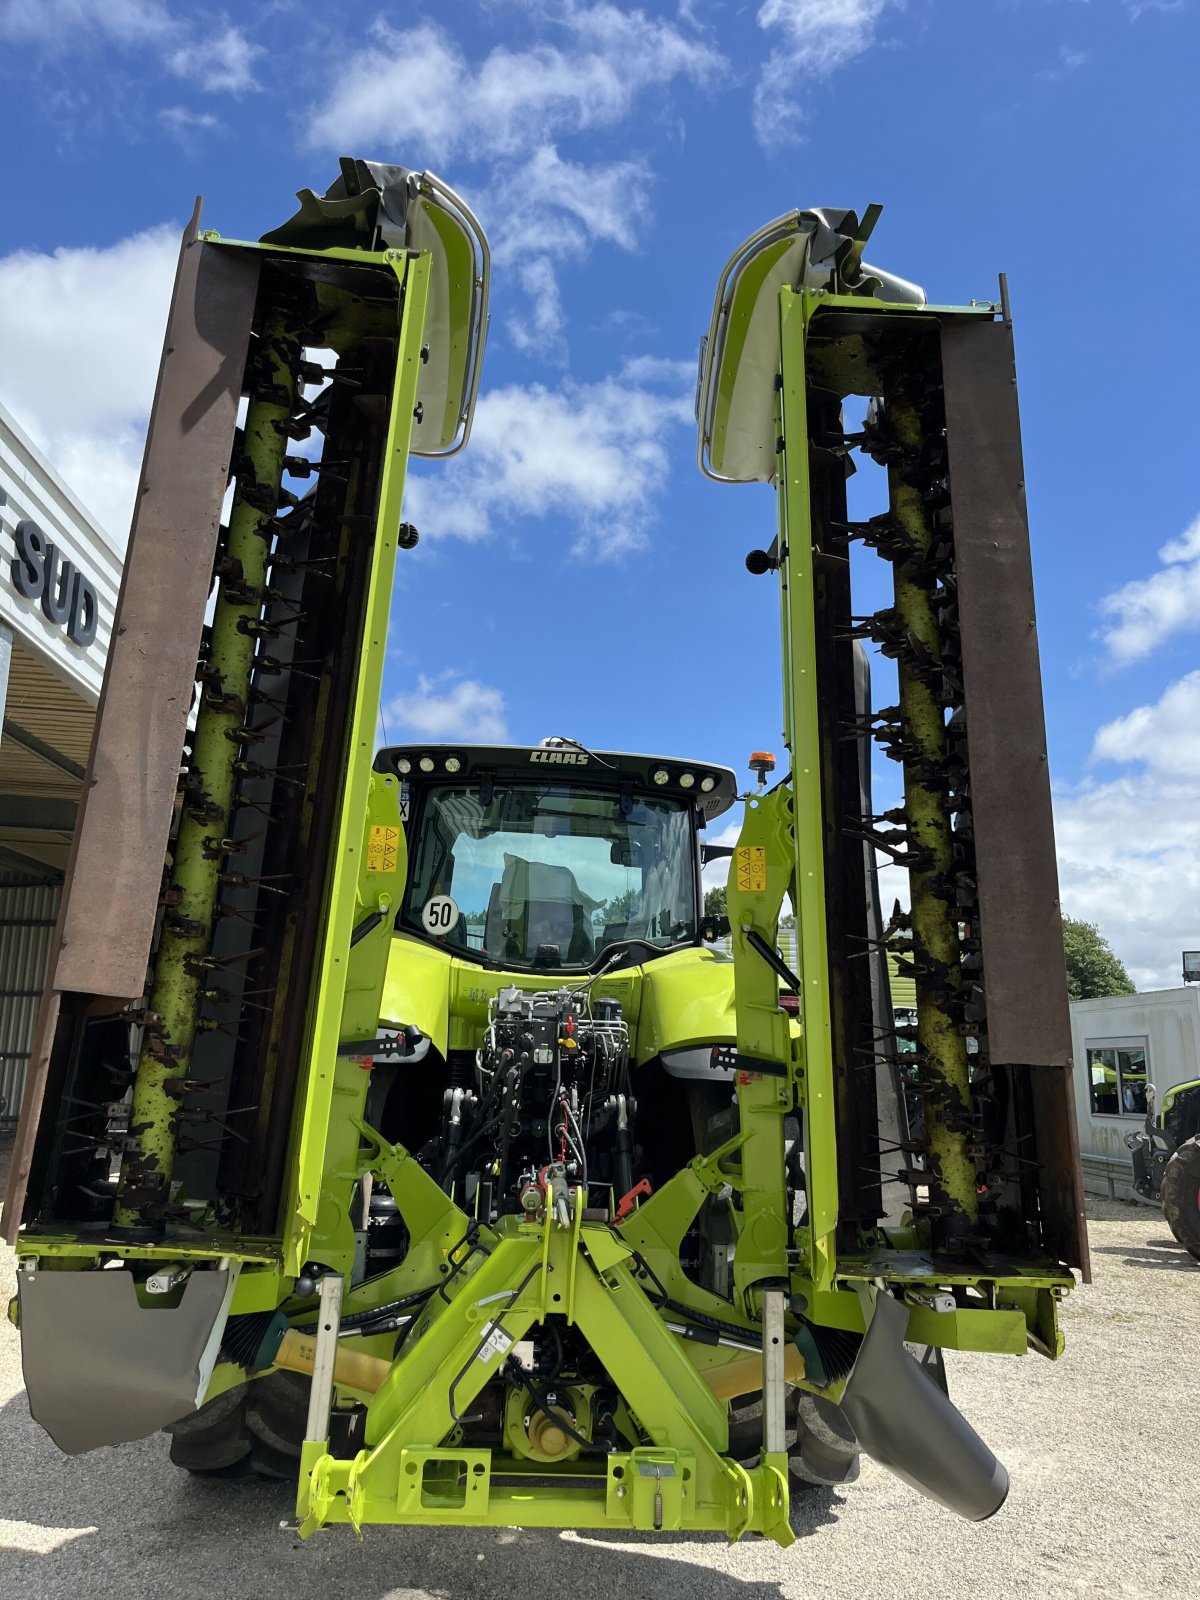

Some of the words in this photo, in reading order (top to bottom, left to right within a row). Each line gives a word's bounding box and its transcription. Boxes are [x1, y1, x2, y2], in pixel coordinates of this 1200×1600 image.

[11, 520, 99, 648] SUD
[530, 751, 589, 765] CLAAS
[429, 902, 452, 928] 50
